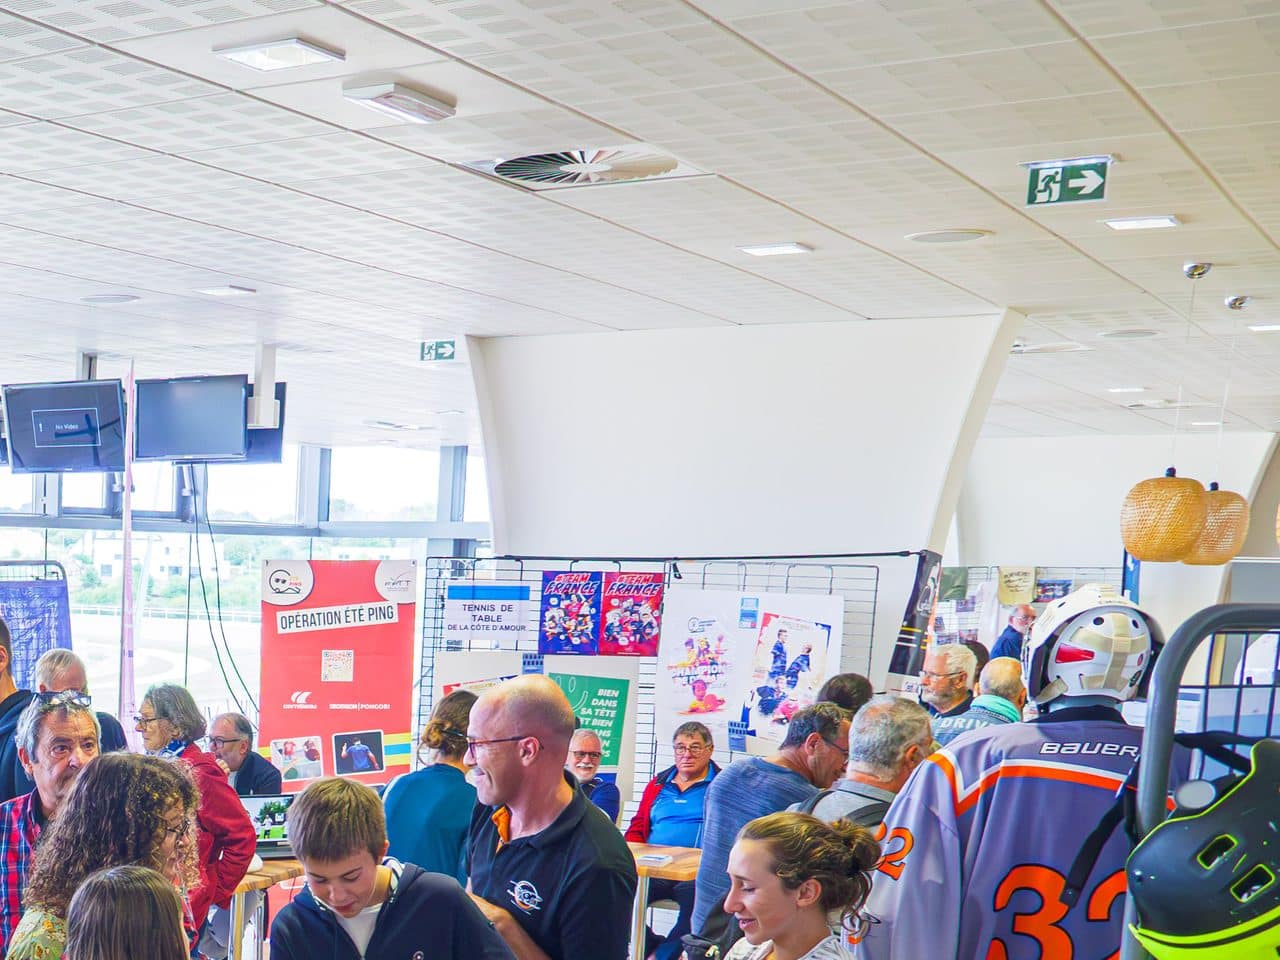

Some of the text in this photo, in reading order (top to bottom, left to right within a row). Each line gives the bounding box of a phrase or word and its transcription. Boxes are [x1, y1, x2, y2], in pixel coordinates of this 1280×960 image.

[544, 580, 600, 595] FRANCE
[605, 582, 661, 596] FRANCE
[462, 603, 513, 612] TENNIS DE
[280, 605, 394, 630] OPÉRATION ÉTÉ PING
[472, 614, 503, 622] TABLE
[470, 623, 490, 631] CÔTE
[597, 688, 620, 697] BIEN
[591, 698, 618, 707] DANS
[580, 707, 592, 715] SA
[591, 718, 613, 727] BIEN
